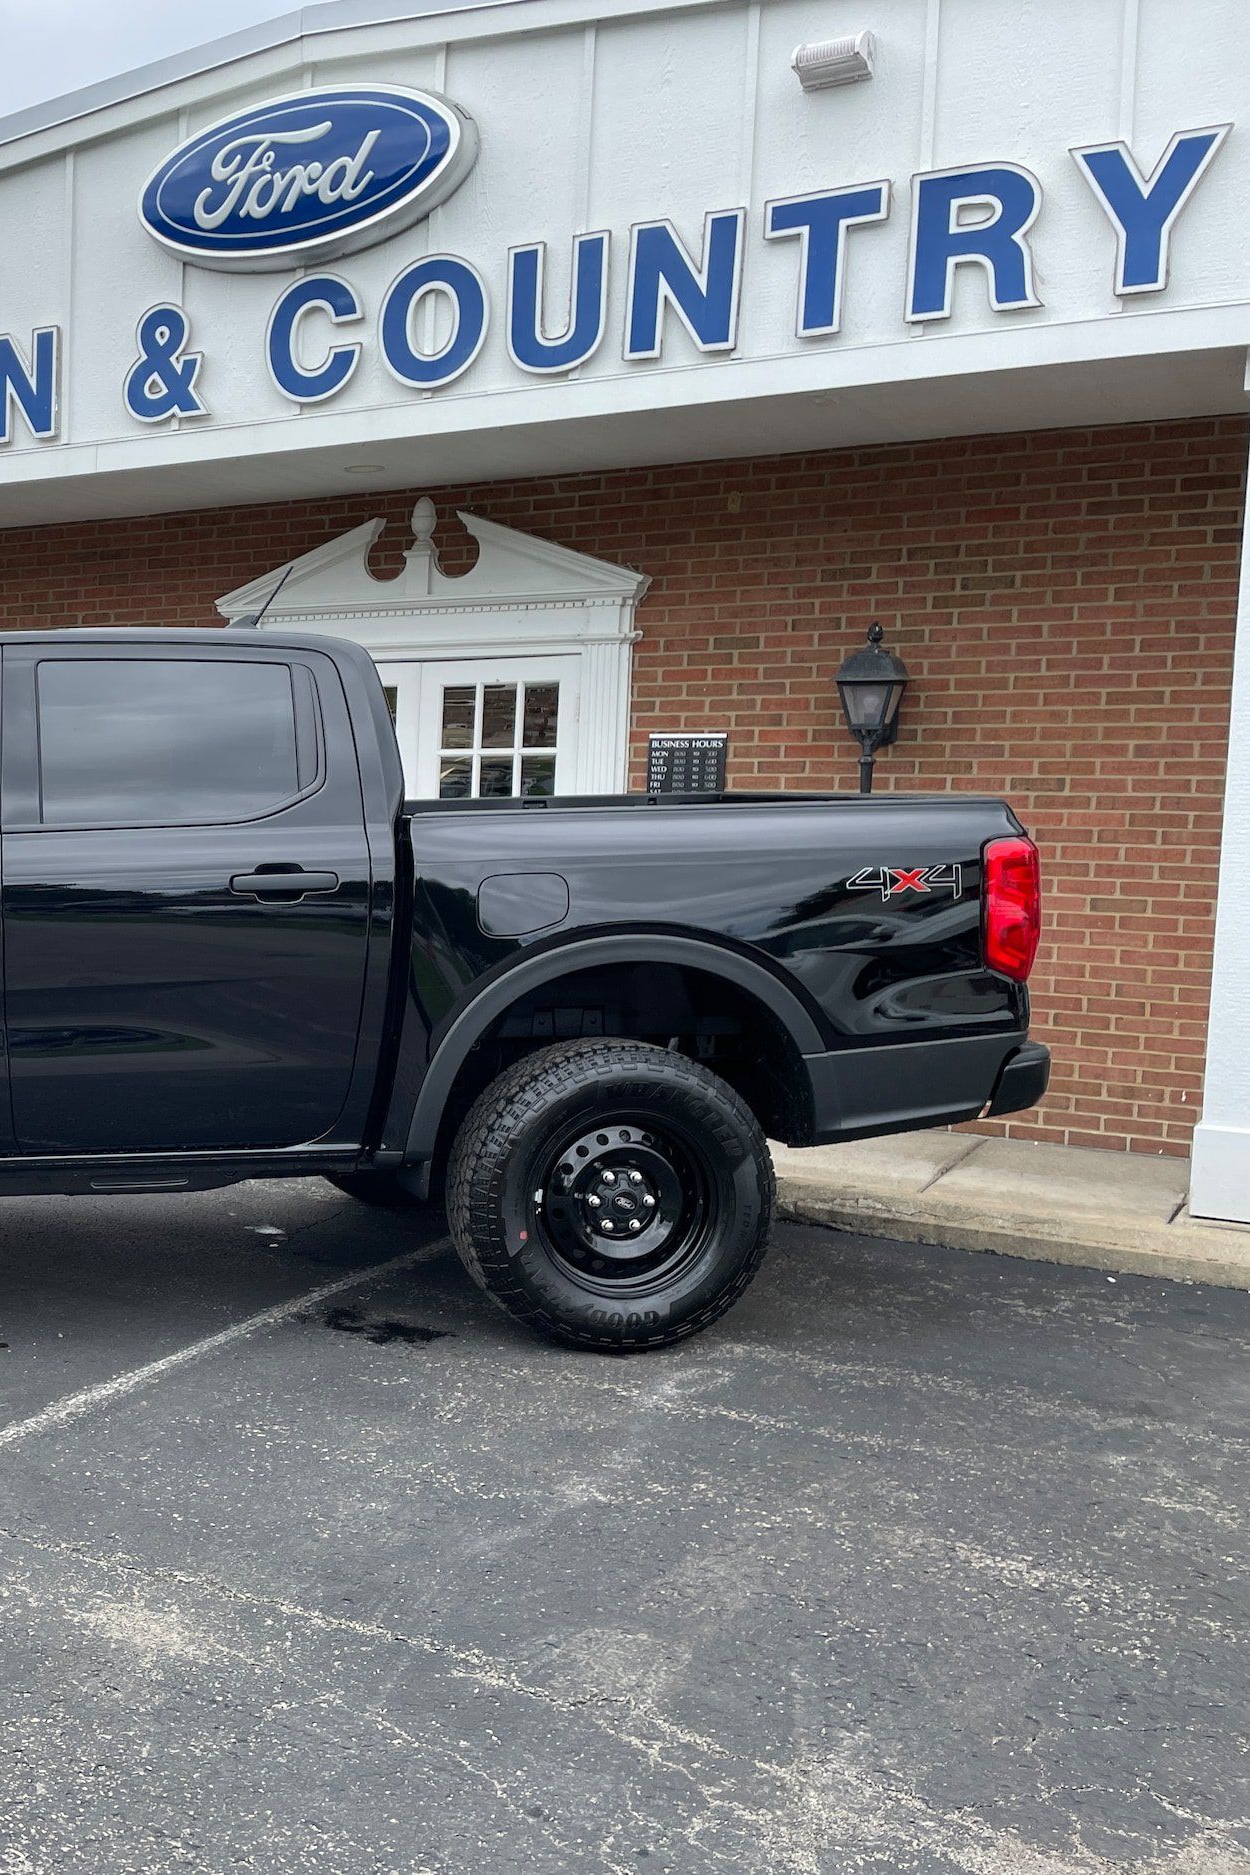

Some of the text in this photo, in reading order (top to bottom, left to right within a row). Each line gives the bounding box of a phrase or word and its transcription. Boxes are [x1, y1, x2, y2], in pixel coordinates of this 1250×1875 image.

[192, 119, 382, 231] Ford
[124, 301, 212, 425] &
[265, 122, 1234, 405] COUNTRY
[651, 740, 724, 748] BUSINESS HOURS
